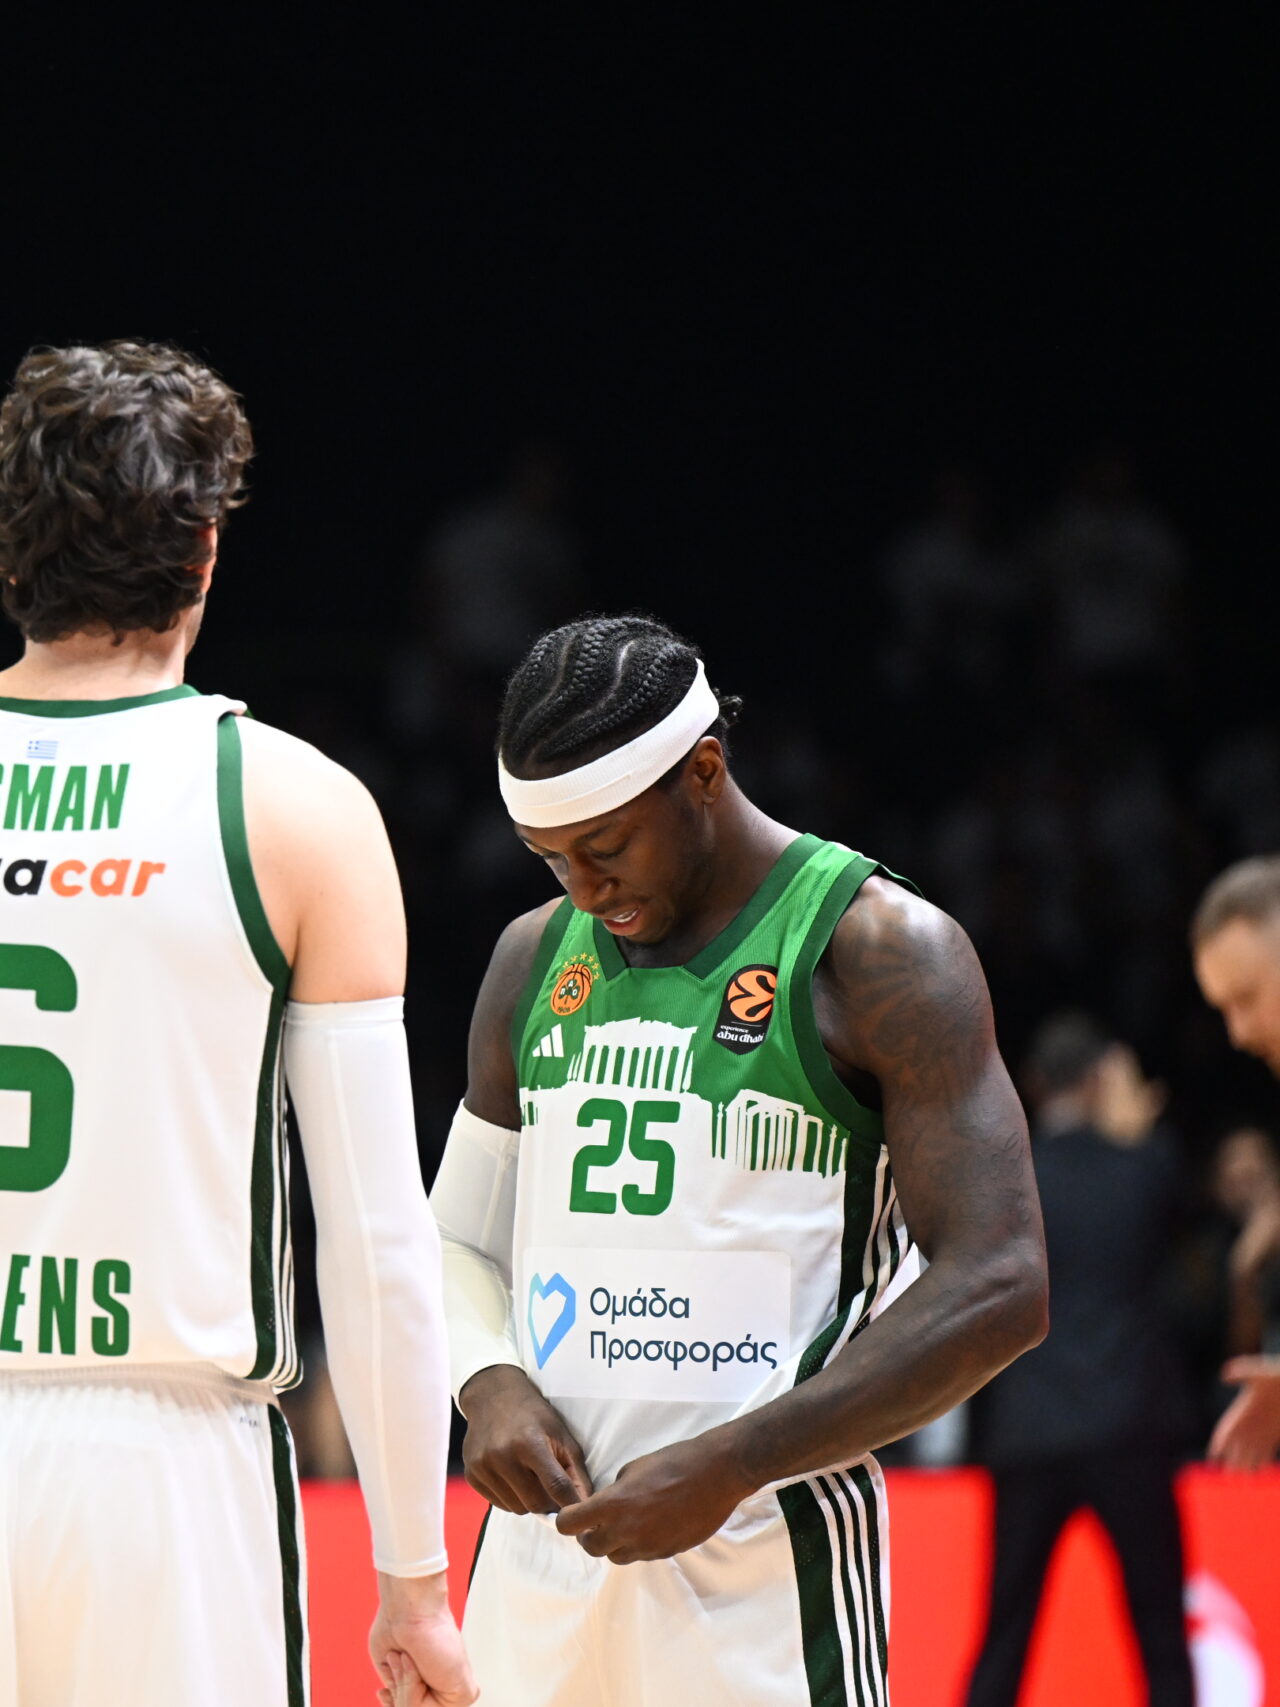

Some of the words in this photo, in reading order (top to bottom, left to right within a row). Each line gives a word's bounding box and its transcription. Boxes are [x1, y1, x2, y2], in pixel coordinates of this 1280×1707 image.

[716, 1030, 738, 1042] abu
[570, 1098, 682, 1216] 25
[590, 1287, 690, 1323] Ομάδα
[590, 1331, 778, 1371] Προσφοράς
